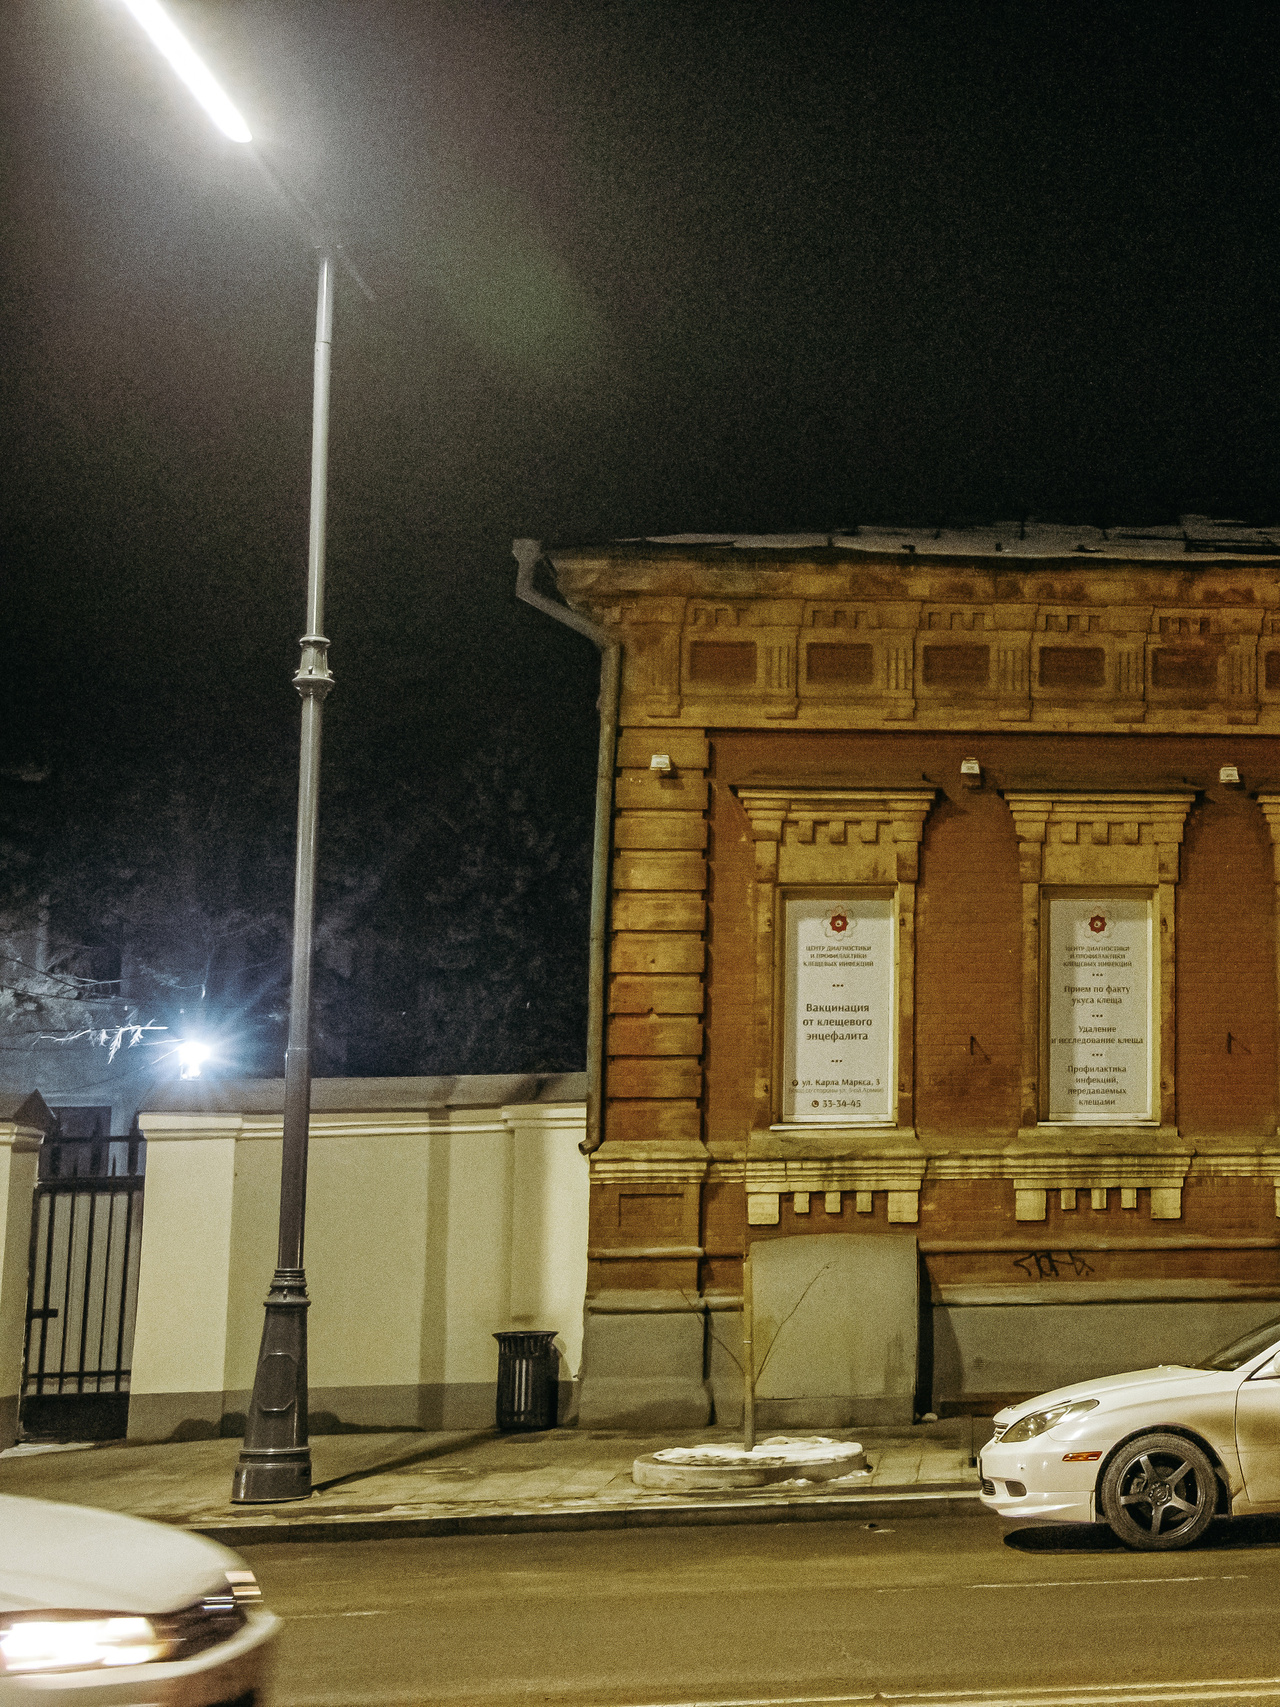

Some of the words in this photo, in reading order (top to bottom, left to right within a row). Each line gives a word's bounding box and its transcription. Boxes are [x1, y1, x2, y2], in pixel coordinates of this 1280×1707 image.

[1064, 986, 1091, 994] Прием
[1094, 986, 1103, 994] по
[1106, 986, 1130, 994] факту
[1072, 997, 1094, 1006] укуса
[807, 1004, 869, 1014] Вакцинация
[817, 1018, 872, 1028] клещевого
[1078, 1025, 1116, 1033] Удаление
[807, 1032, 868, 1042] энцефалита
[1068, 1065, 1126, 1073] Профилактика
[816, 1079, 839, 1087] Карла
[842, 1079, 873, 1087] Маркса,
[876, 1078, 880, 1086] 3
